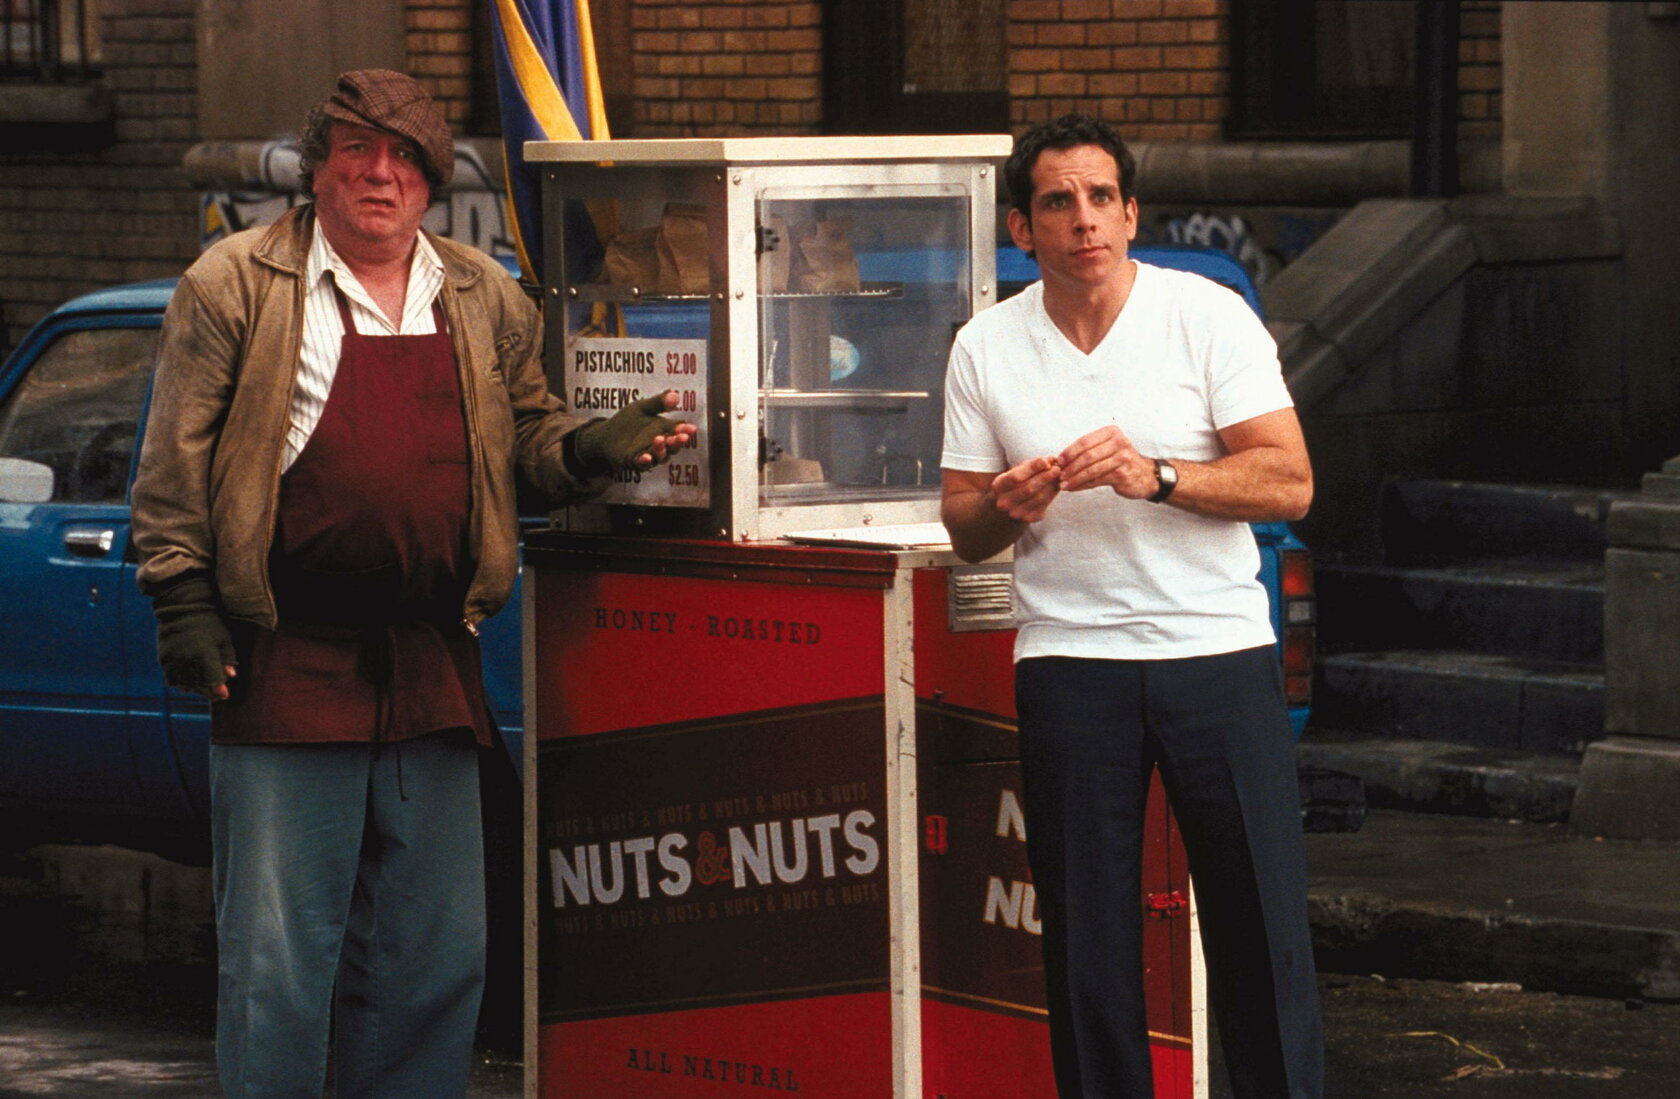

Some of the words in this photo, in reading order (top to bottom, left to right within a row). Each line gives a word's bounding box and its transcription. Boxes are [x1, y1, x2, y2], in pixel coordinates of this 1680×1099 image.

[575, 350, 654, 374] PISTACHIOS
[666, 352, 697, 375] $2.00
[574, 387, 640, 411] CASHEWS
[668, 464, 699, 486] $2.50
[594, 608, 678, 634] HONEY
[707, 615, 823, 646] ROASTED
[657, 804, 693, 826] NUTS
[714, 797, 749, 819] NUTS
[771, 790, 808, 811] NUTS
[831, 782, 868, 804] NUTS
[549, 832, 692, 909] NUTS
[728, 809, 881, 889] NUTS
[666, 902, 702, 924] NUTS
[724, 896, 760, 918] NUTS
[782, 890, 819, 911] NUTS
[842, 884, 879, 905] NUTS
[983, 875, 1043, 936] NU
[627, 1048, 673, 1075] ALL
[684, 1055, 800, 1092] NATURAL
